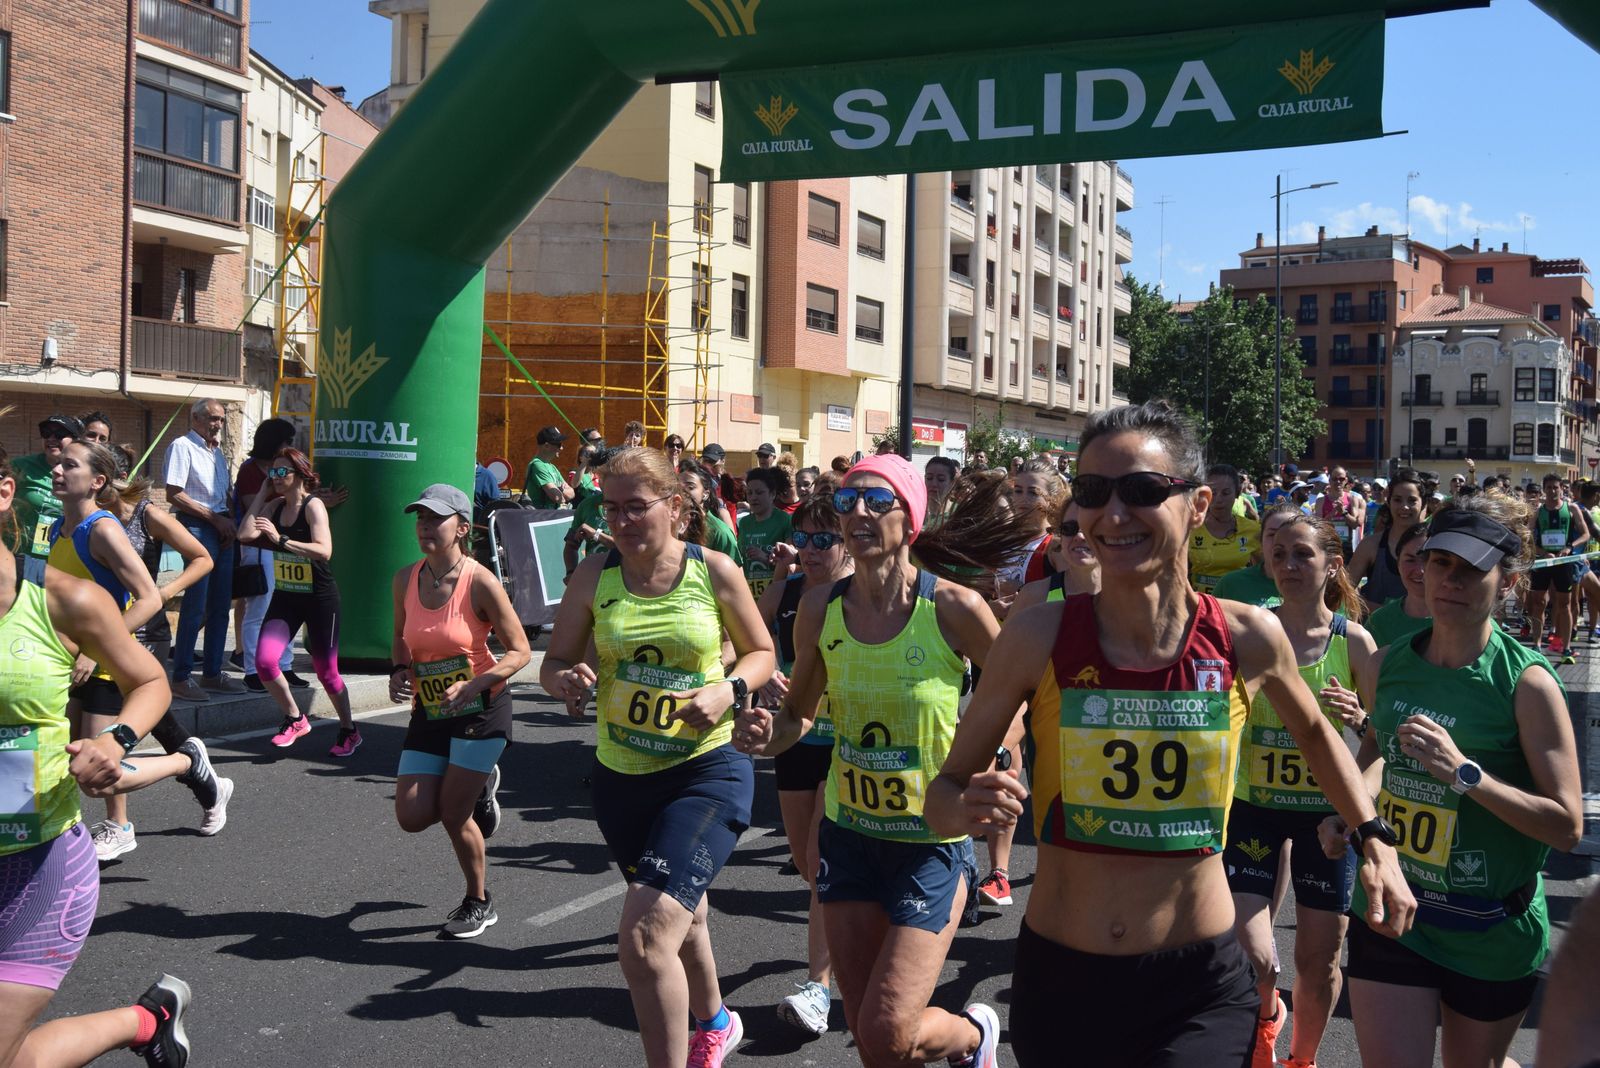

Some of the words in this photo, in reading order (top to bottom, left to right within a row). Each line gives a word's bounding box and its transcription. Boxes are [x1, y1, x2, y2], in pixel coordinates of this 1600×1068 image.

[830, 60, 1236, 150] SALIDA
[1258, 101, 1296, 118] CAJA
[1297, 96, 1353, 114] RURAL
[742, 142, 768, 155] CAJA
[769, 138, 813, 153] RURAL
[380, 451, 409, 459] ZAMORA
[280, 563, 305, 581] 110
[641, 676, 660, 687] CAJA
[662, 681, 692, 690] RURAL
[642, 666, 694, 684] FUNDACION
[628, 690, 677, 731] 60
[1113, 698, 1209, 714] FUNDACION
[1113, 713, 1152, 727] CAJA
[1157, 714, 1209, 727] RURAL
[628, 736, 652, 750] CAJA
[654, 741, 689, 754] RURAL
[851, 750, 907, 763] FUNDACION
[852, 757, 871, 770] CAJA
[873, 760, 907, 770] RURAL
[1102, 739, 1189, 801] 39
[843, 768, 909, 811] 103
[1391, 774, 1446, 796] FUNDACION
[1274, 795, 1298, 805] CAJA
[1300, 796, 1331, 805] RURA
[1409, 788, 1445, 806] RURAL
[859, 818, 882, 831] CAJA
[885, 819, 924, 832] RURAL
[1109, 820, 1154, 838] CAJA
[1158, 819, 1213, 838] RURAL
[1383, 799, 1437, 855] 150
[1241, 867, 1273, 881] AQUONA
[1424, 890, 1448, 903] BBVA
